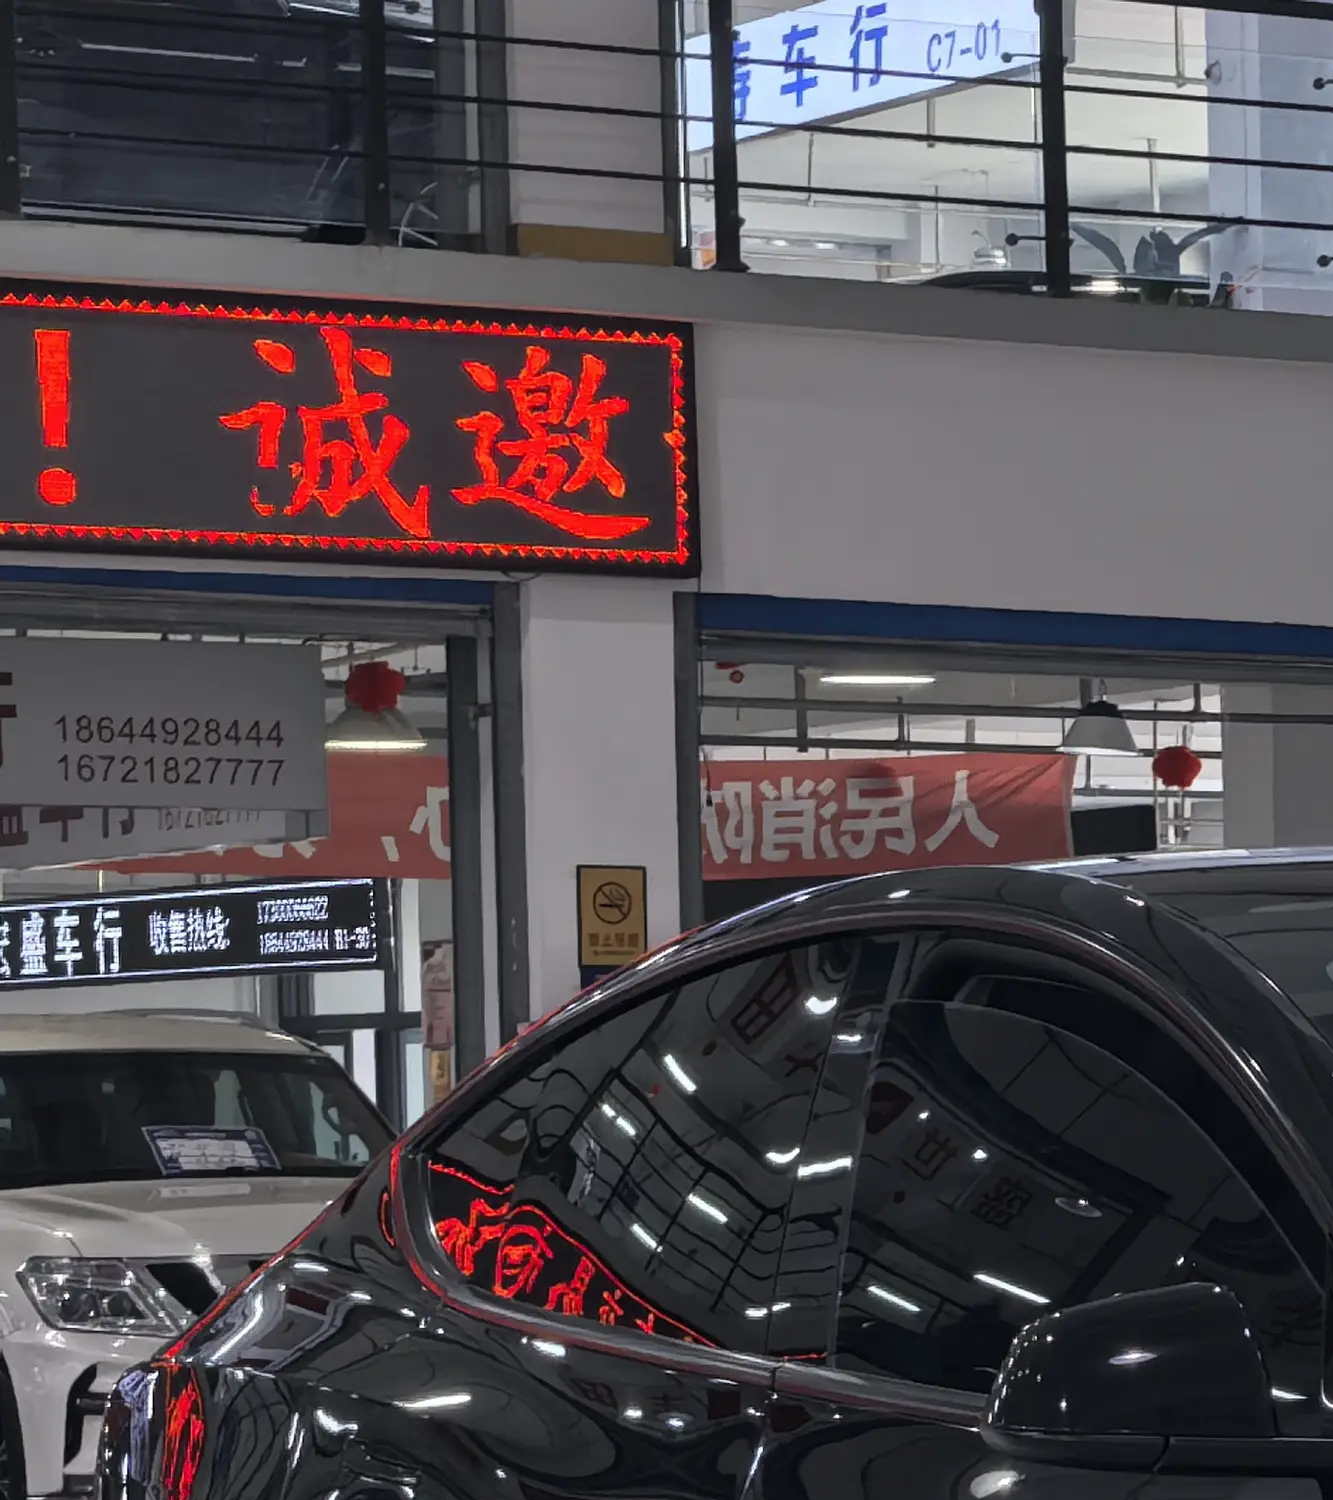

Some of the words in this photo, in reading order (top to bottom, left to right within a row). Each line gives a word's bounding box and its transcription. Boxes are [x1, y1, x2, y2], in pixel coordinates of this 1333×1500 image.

[926, 19, 1001, 73] C7-01
[219, 327, 650, 539] 诚邀
[54, 715, 285, 748] 18644928444
[57, 754, 285, 787] 16721827777
[0, 906, 122, 978] 盛车行
